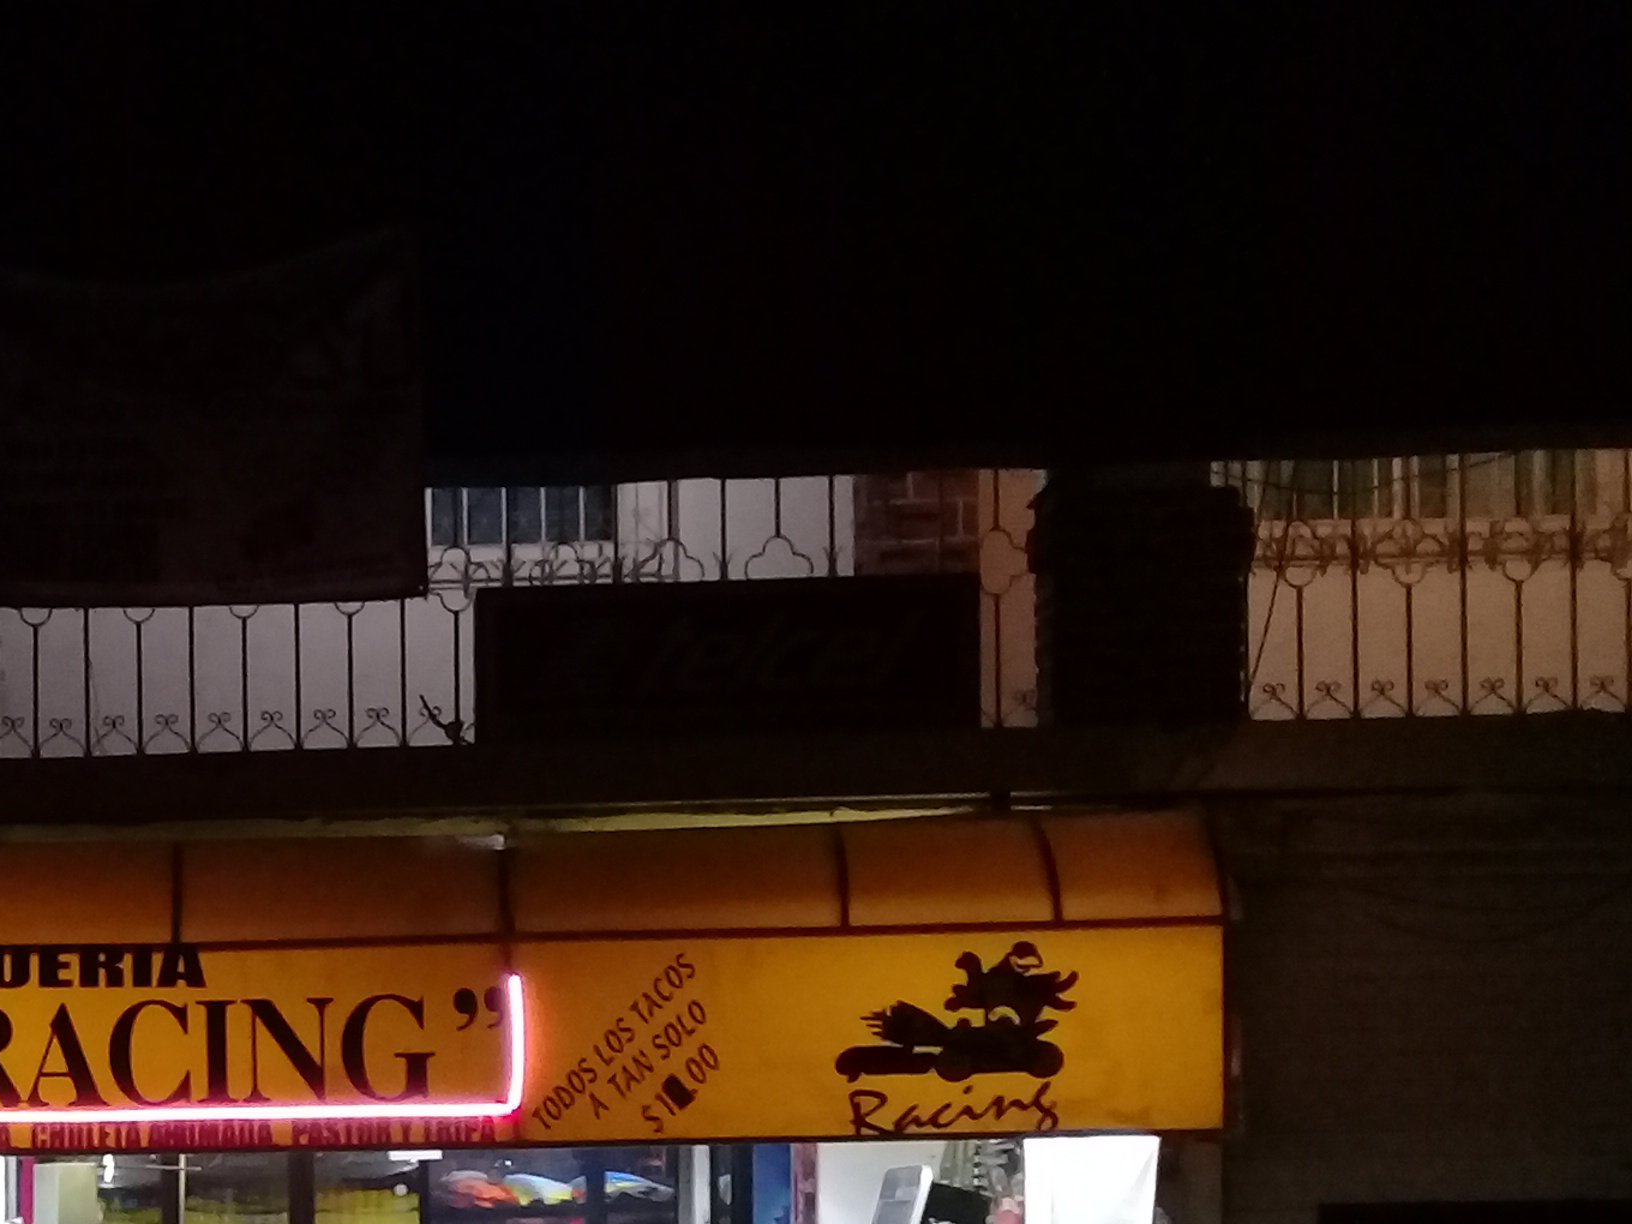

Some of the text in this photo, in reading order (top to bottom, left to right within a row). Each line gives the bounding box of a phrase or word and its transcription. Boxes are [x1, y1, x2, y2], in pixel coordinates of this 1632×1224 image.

[532, 953, 696, 1130] TODOS LOS TACOS
[587, 1000, 707, 1120] A TAN SOLO
[641, 1043, 719, 1133] $1.00
[850, 1081, 1060, 1133] Racing
